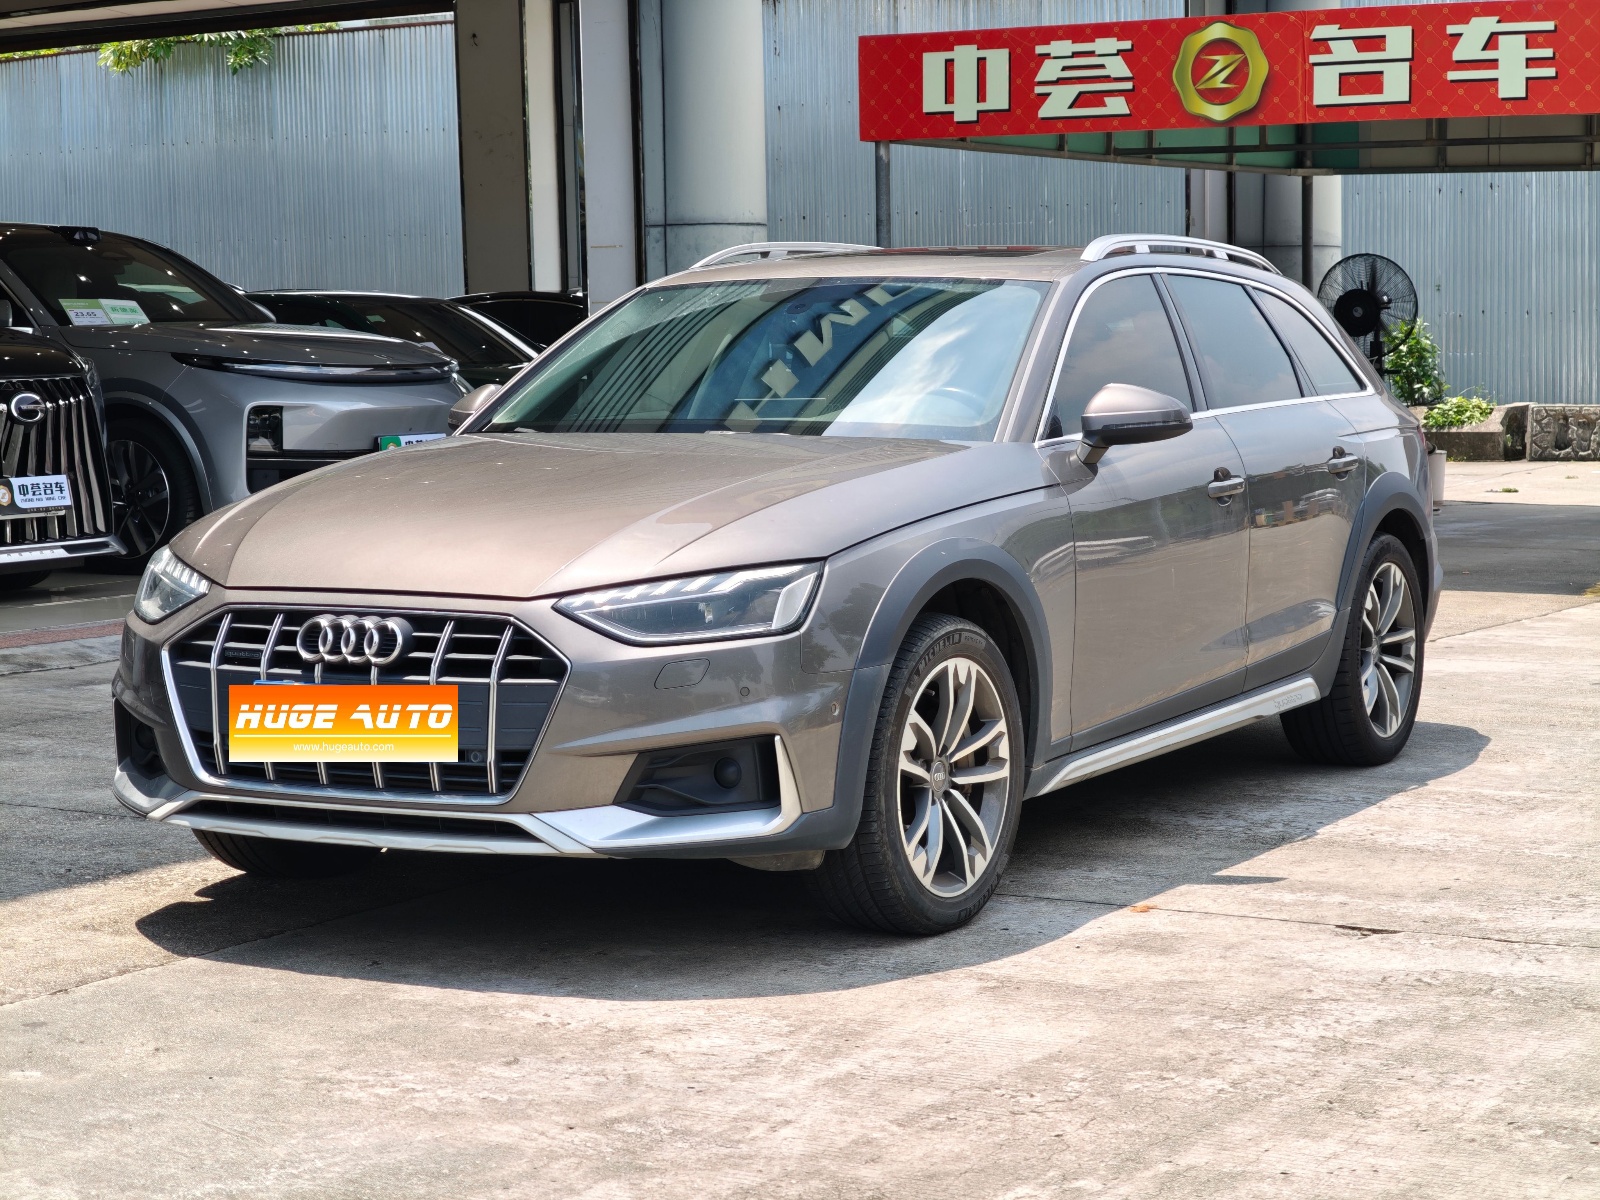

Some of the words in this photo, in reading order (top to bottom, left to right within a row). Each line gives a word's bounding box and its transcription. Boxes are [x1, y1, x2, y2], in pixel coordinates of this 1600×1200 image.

[922, 38, 1134, 122] 中荟
[1308, 16, 1556, 106] 名车
[18, 482, 65, 496] 中荟名车
[918, 632, 962, 671] MICHELIN
